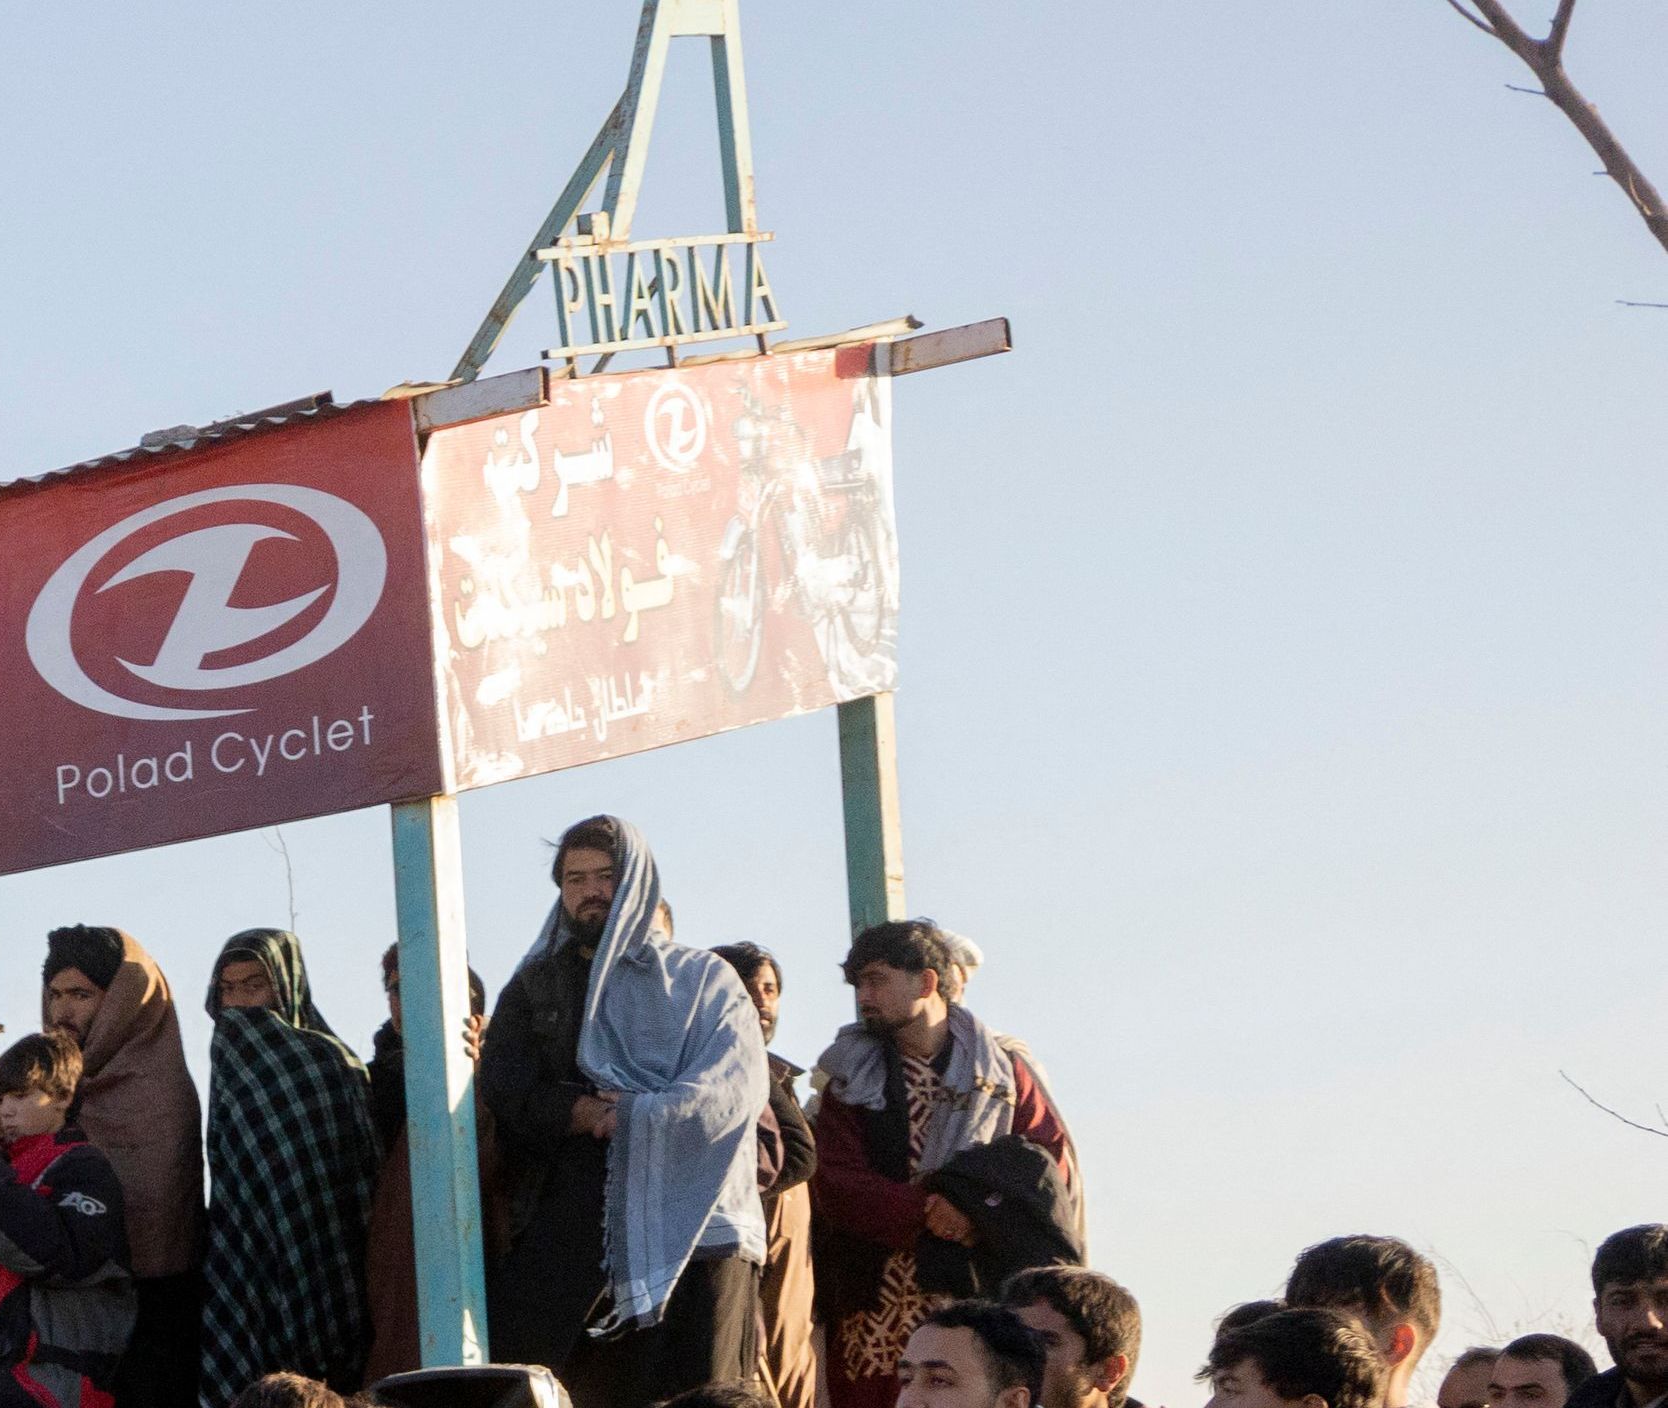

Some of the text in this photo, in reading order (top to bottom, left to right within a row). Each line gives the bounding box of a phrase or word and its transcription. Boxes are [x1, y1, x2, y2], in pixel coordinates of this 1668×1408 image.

[554, 242, 781, 352] PHARMA
[55, 706, 377, 806] Polad Cyclet
